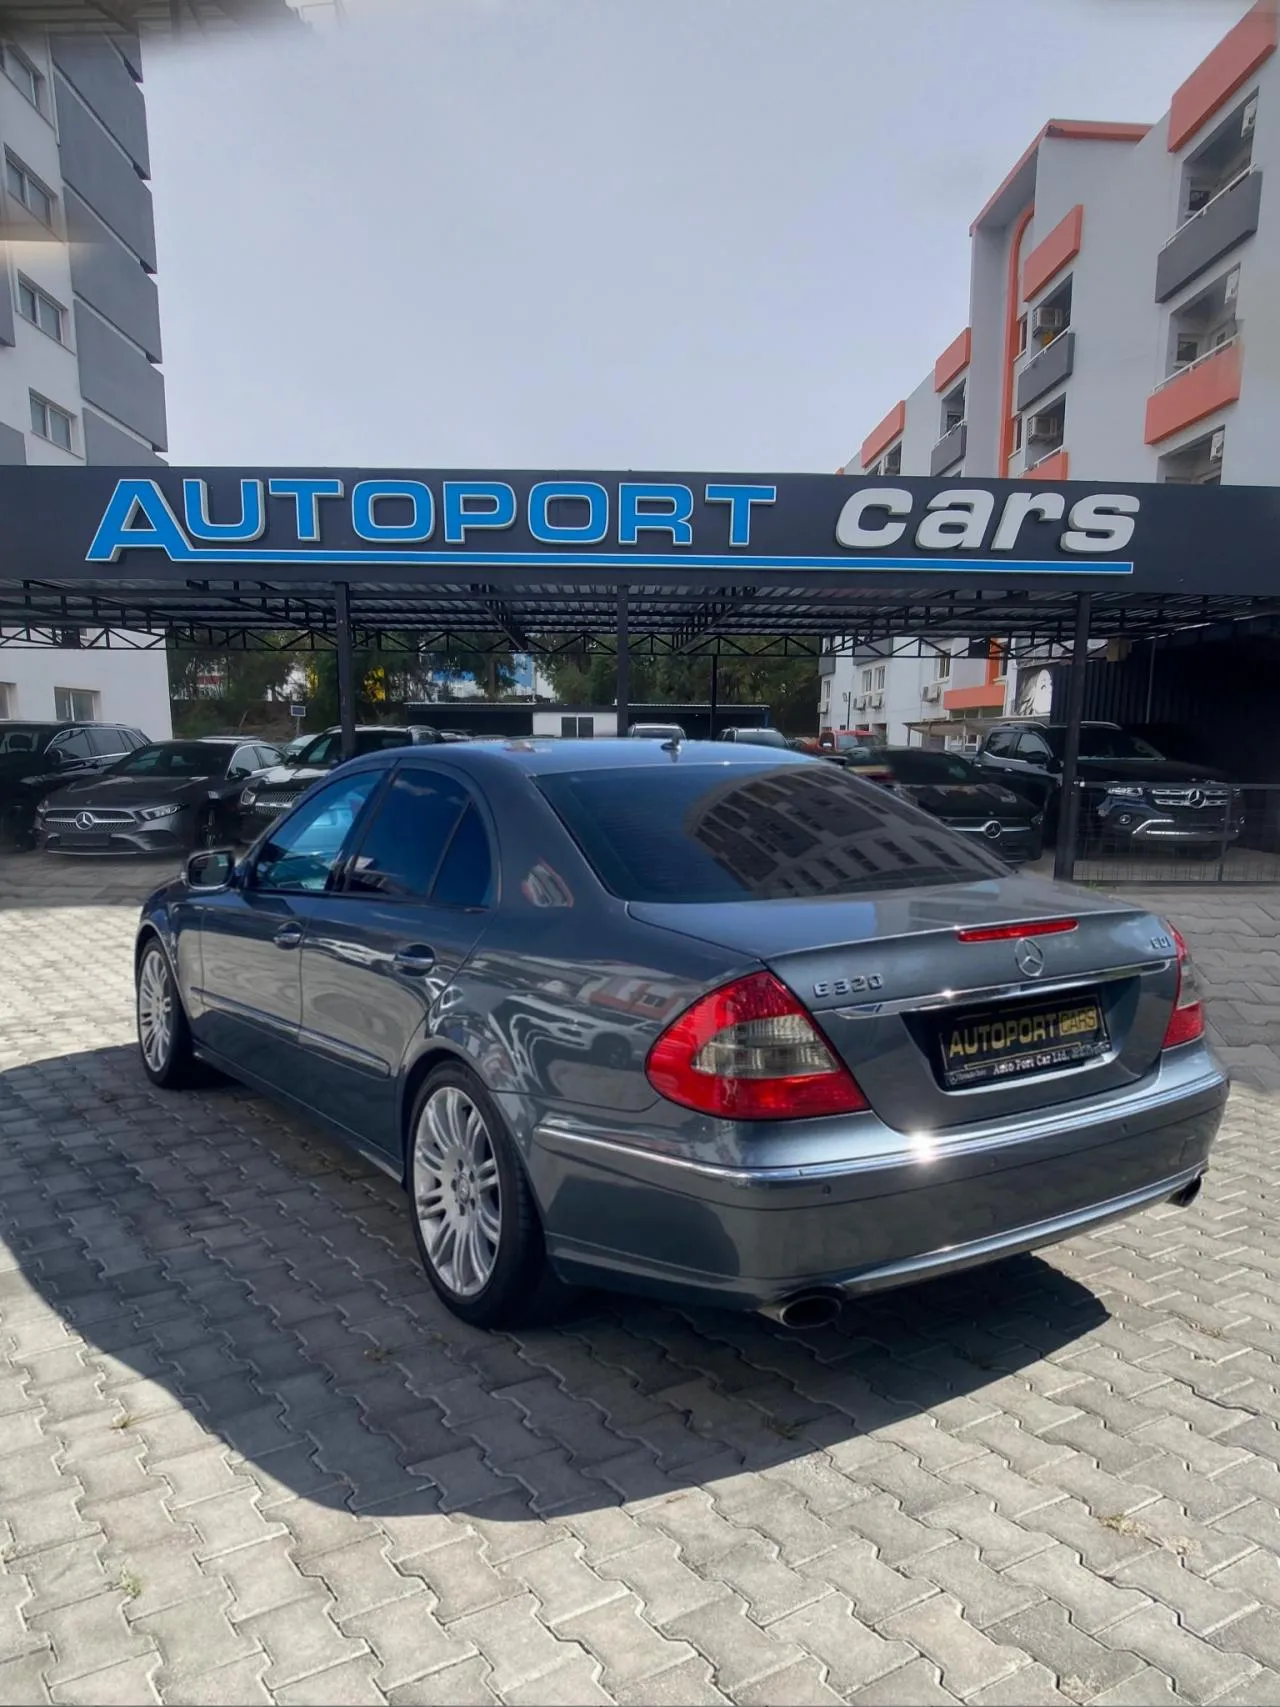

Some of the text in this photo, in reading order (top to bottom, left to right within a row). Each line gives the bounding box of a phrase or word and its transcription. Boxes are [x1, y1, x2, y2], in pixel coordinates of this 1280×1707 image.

[85, 478, 1140, 563] AUTOPORT cars
[949, 1013, 1057, 1058] AUTOPORT
[1060, 1007, 1097, 1034] CARS
